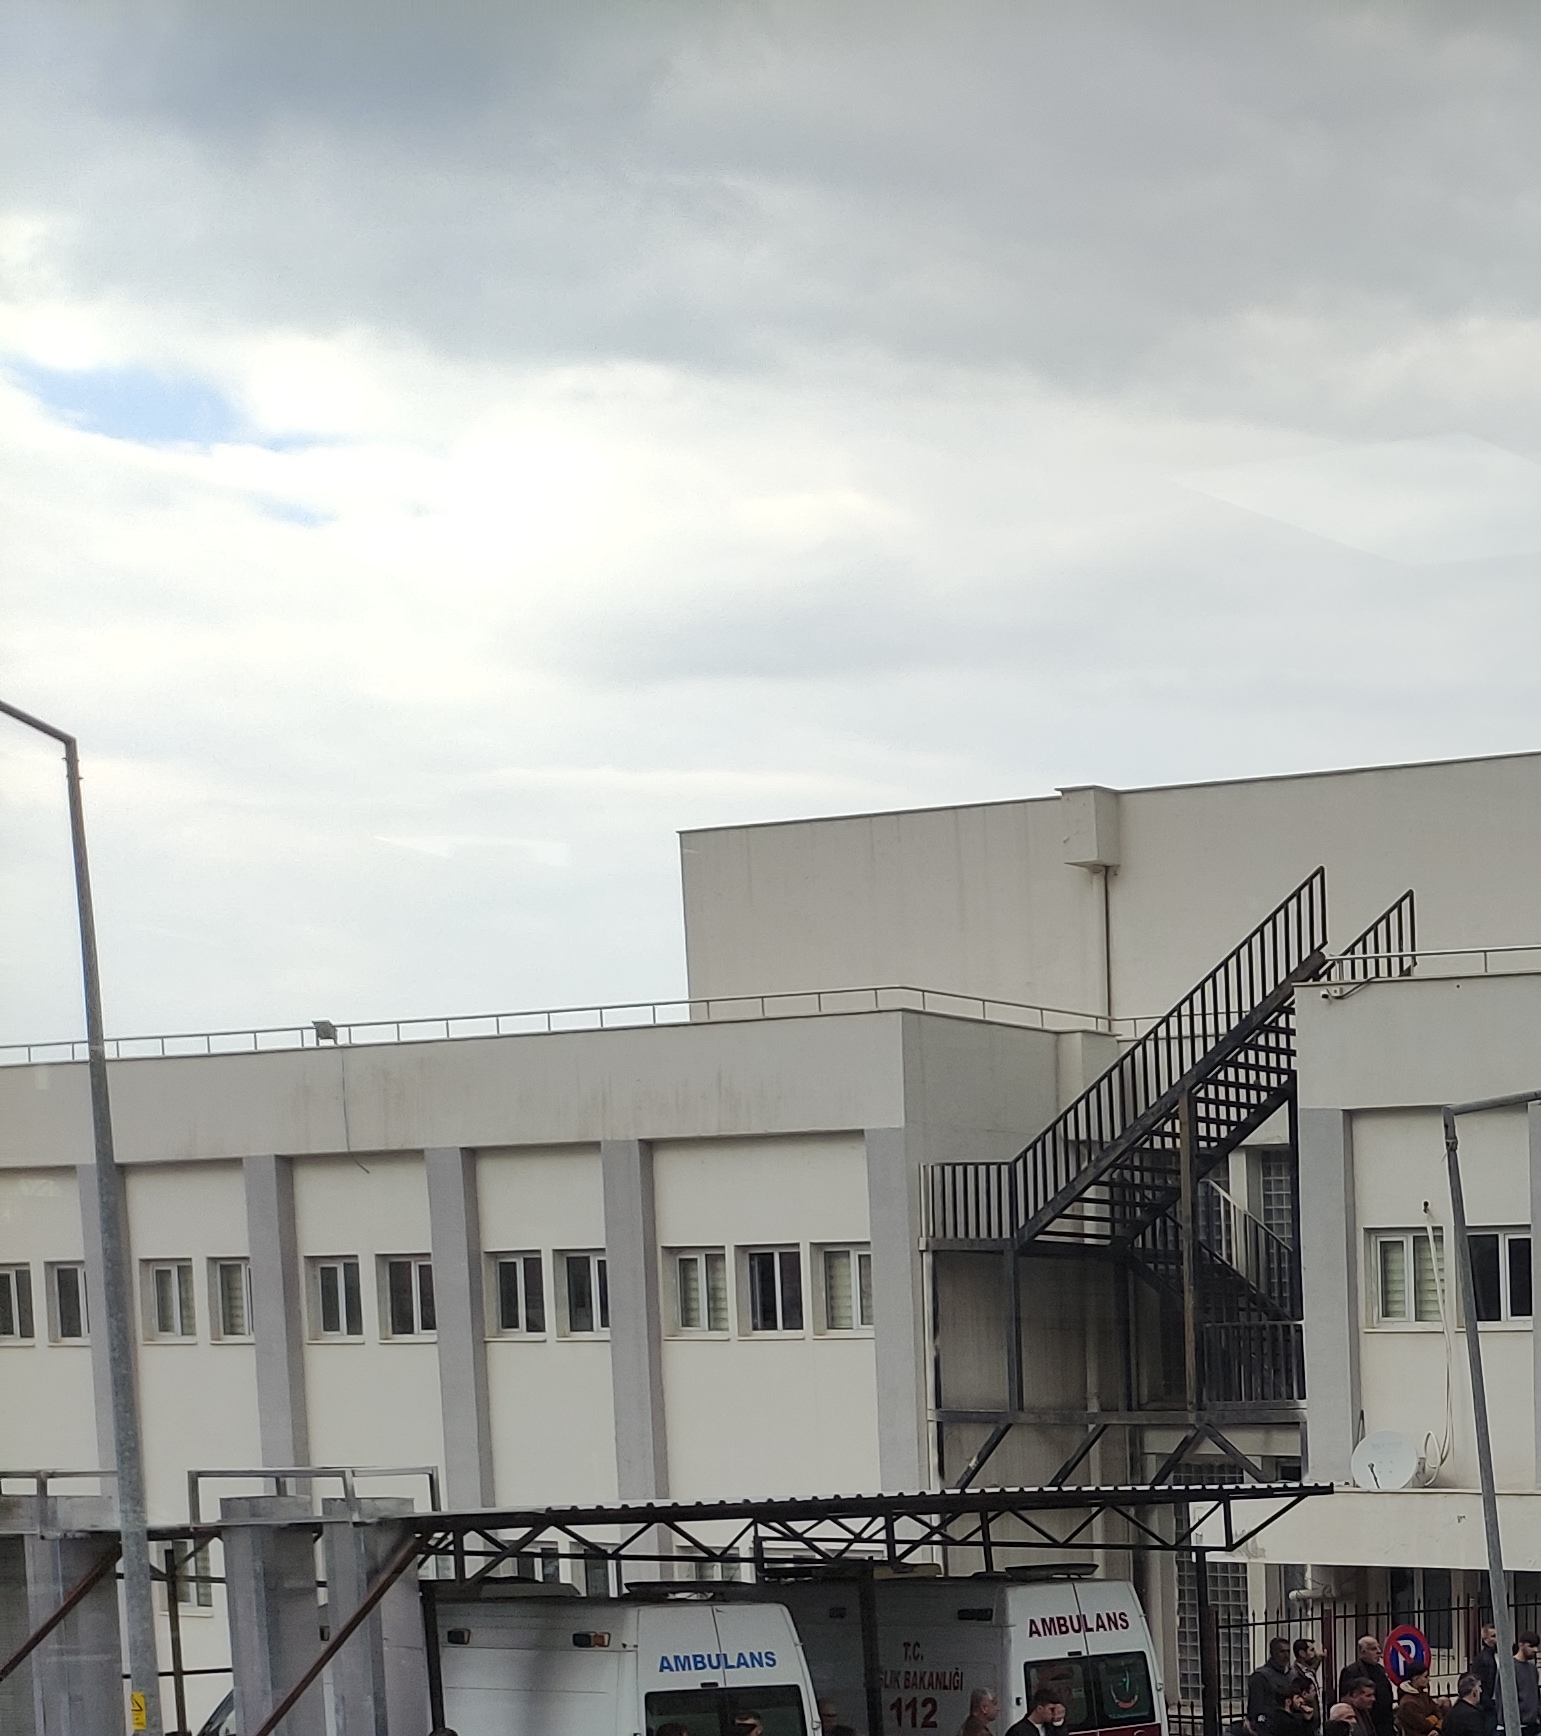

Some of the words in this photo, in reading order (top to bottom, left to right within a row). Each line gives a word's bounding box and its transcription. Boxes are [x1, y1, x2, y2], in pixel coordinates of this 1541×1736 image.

[1028, 1611, 1130, 1638] AMBULANS
[658, 1651, 777, 1672] AMBULANS
[903, 1641, 924, 1661] T.C.
[903, 1667, 964, 1691] BAKANLIĞI
[890, 1697, 938, 1728] 112
